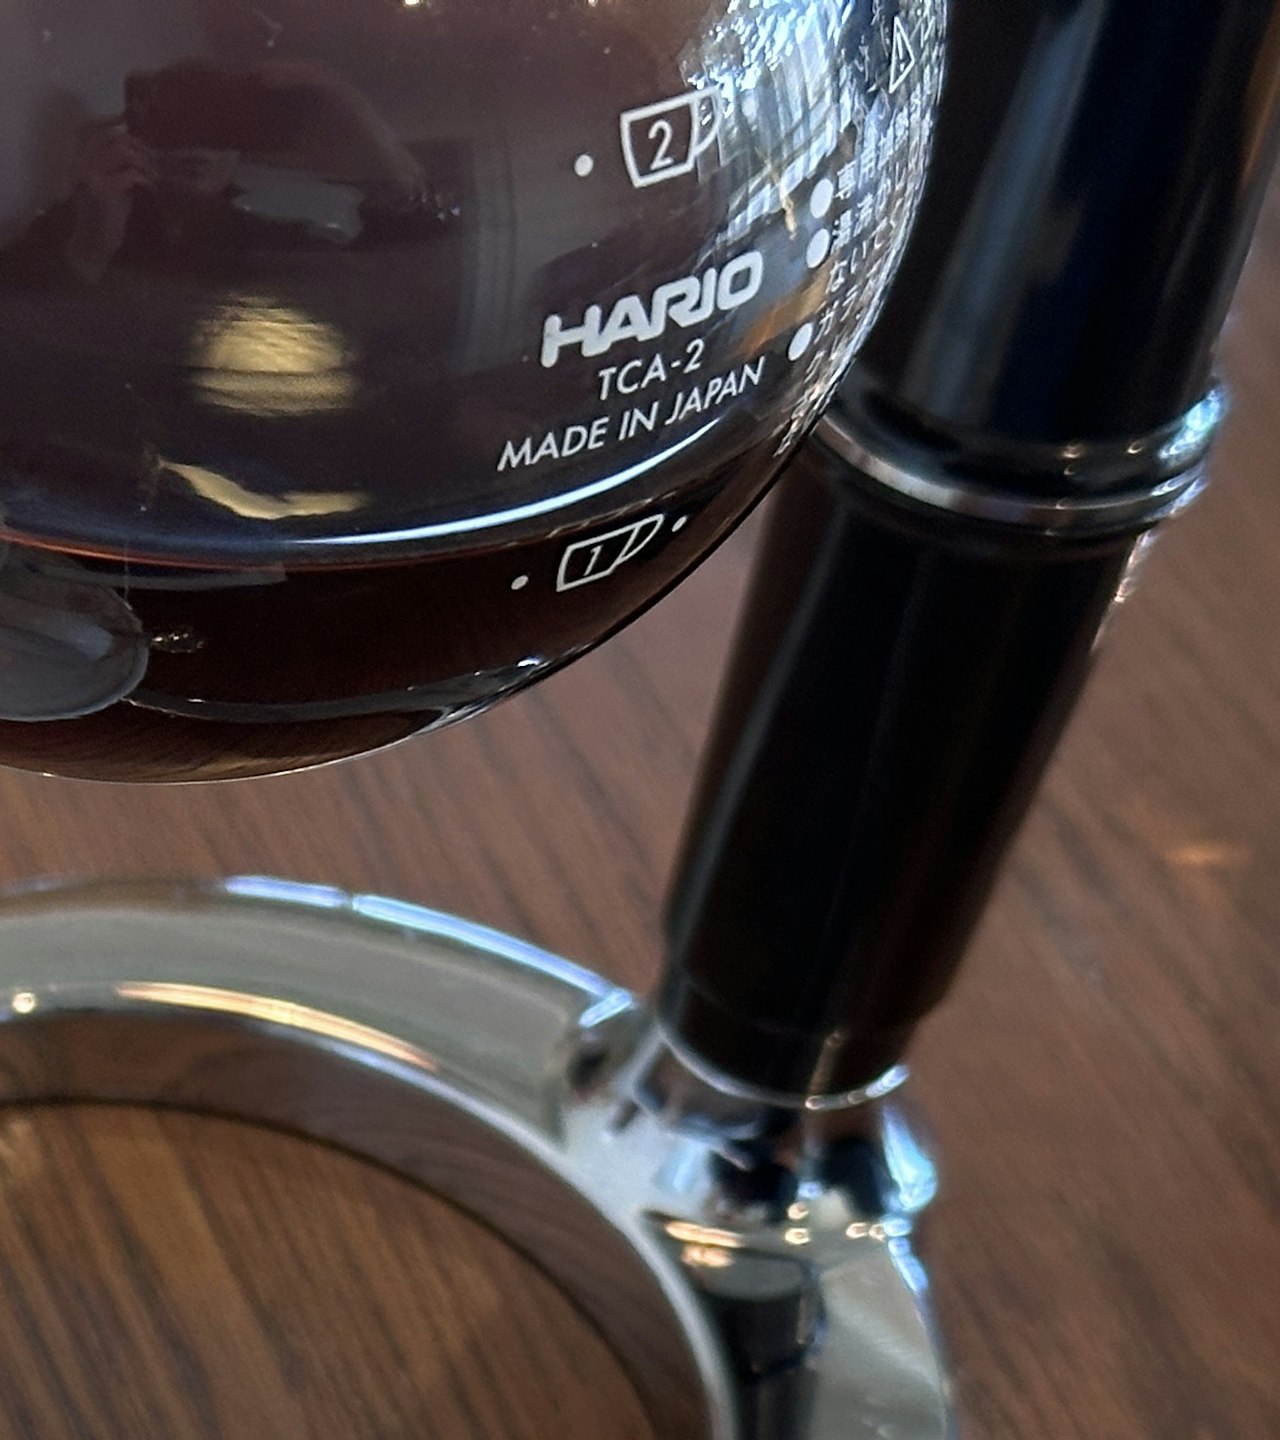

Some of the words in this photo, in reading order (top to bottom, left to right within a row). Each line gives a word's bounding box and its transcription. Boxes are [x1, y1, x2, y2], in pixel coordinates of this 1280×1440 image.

[647, 119, 674, 170] 2
[541, 250, 764, 368] HARIO
[598, 338, 705, 400] TCA-2
[496, 416, 609, 472] MADE
[618, 402, 659, 441] IN
[664, 356, 765, 425] JAPAN
[583, 543, 604, 577] 1
